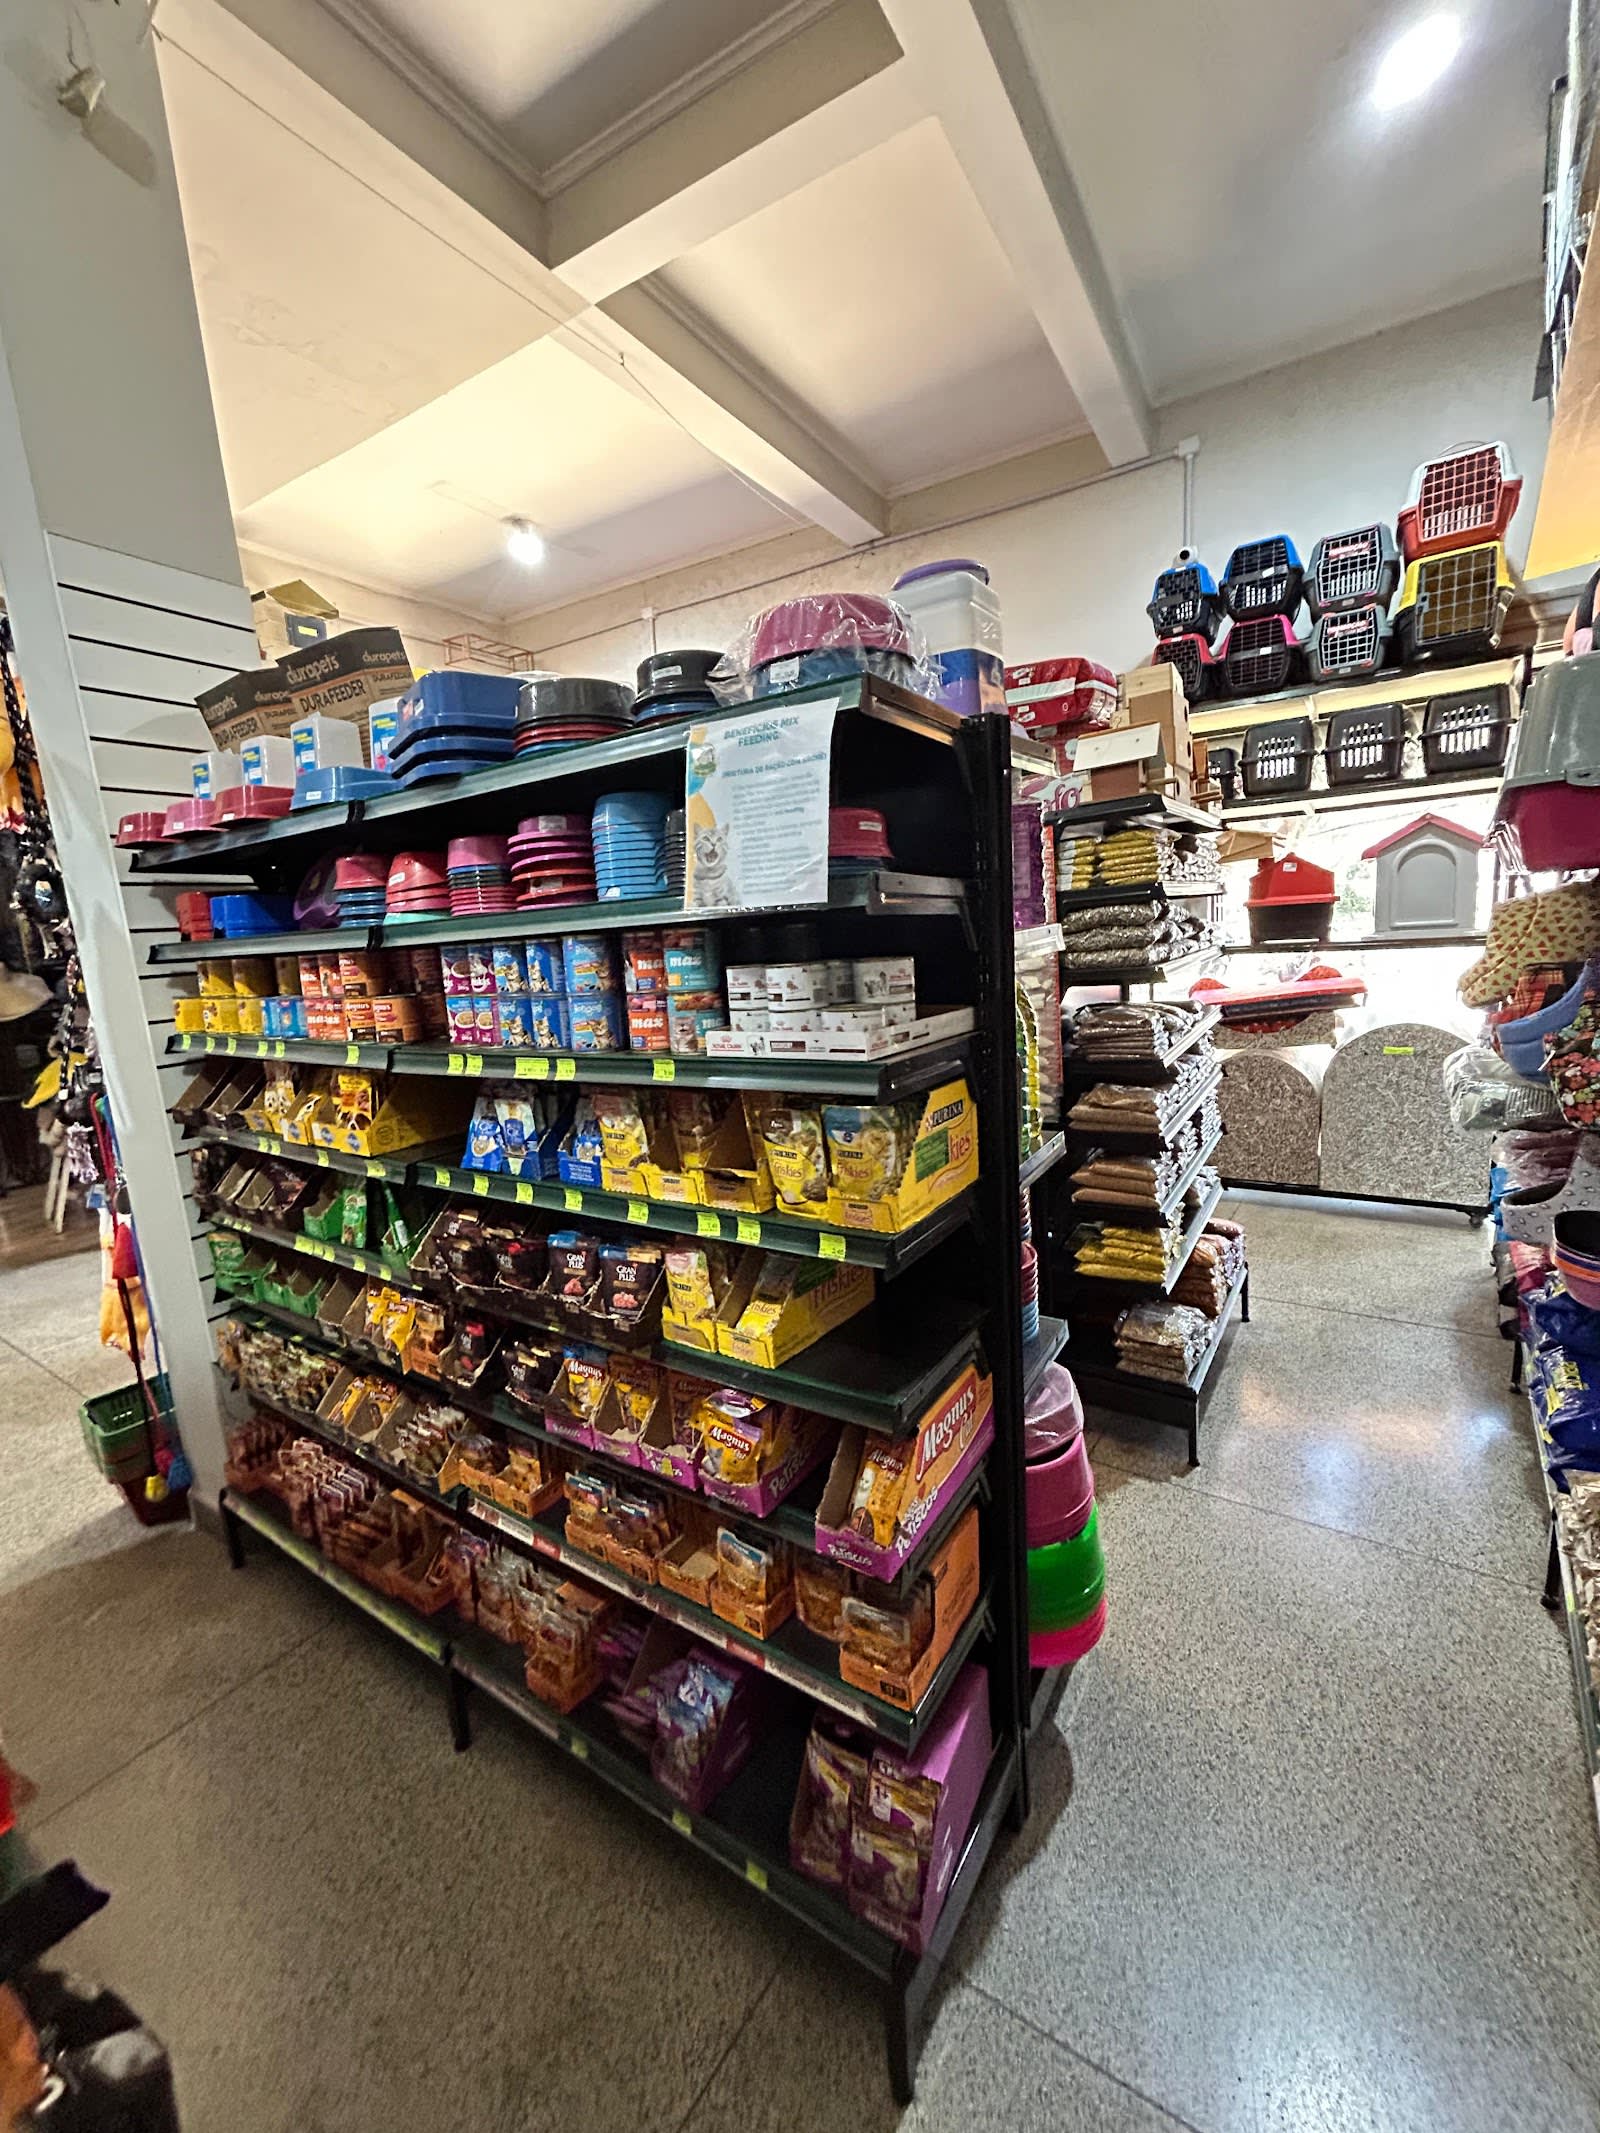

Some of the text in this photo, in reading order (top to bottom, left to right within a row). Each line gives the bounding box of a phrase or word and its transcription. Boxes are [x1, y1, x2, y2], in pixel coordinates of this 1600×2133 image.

[362, 651, 405, 663] durapets
[286, 654, 339, 685] durapets
[300, 679, 366, 713] DURAFEEDER
[780, 717, 799, 728] MIX
[738, 731, 780, 747] FEEDING
[637, 959, 664, 970] ma
[670, 956, 702, 967] max
[631, 1018, 664, 1029] max
[702, 1018, 725, 1029] ma
[932, 1099, 963, 1127] PURINA
[951, 1133, 970, 1161] kies
[566, 1252, 585, 1263] GRAN
[568, 1260, 585, 1270] PLUS
[616, 1265, 637, 1275] GRAN
[618, 1273, 636, 1282] PLUS
[813, 1265, 864, 1306] Friskies
[568, 1359, 603, 1379] Magnus
[710, 1426, 750, 1452] Magnus
[916, 1385, 975, 1481] Magnus
[870, 1449, 904, 1471] Magnus
